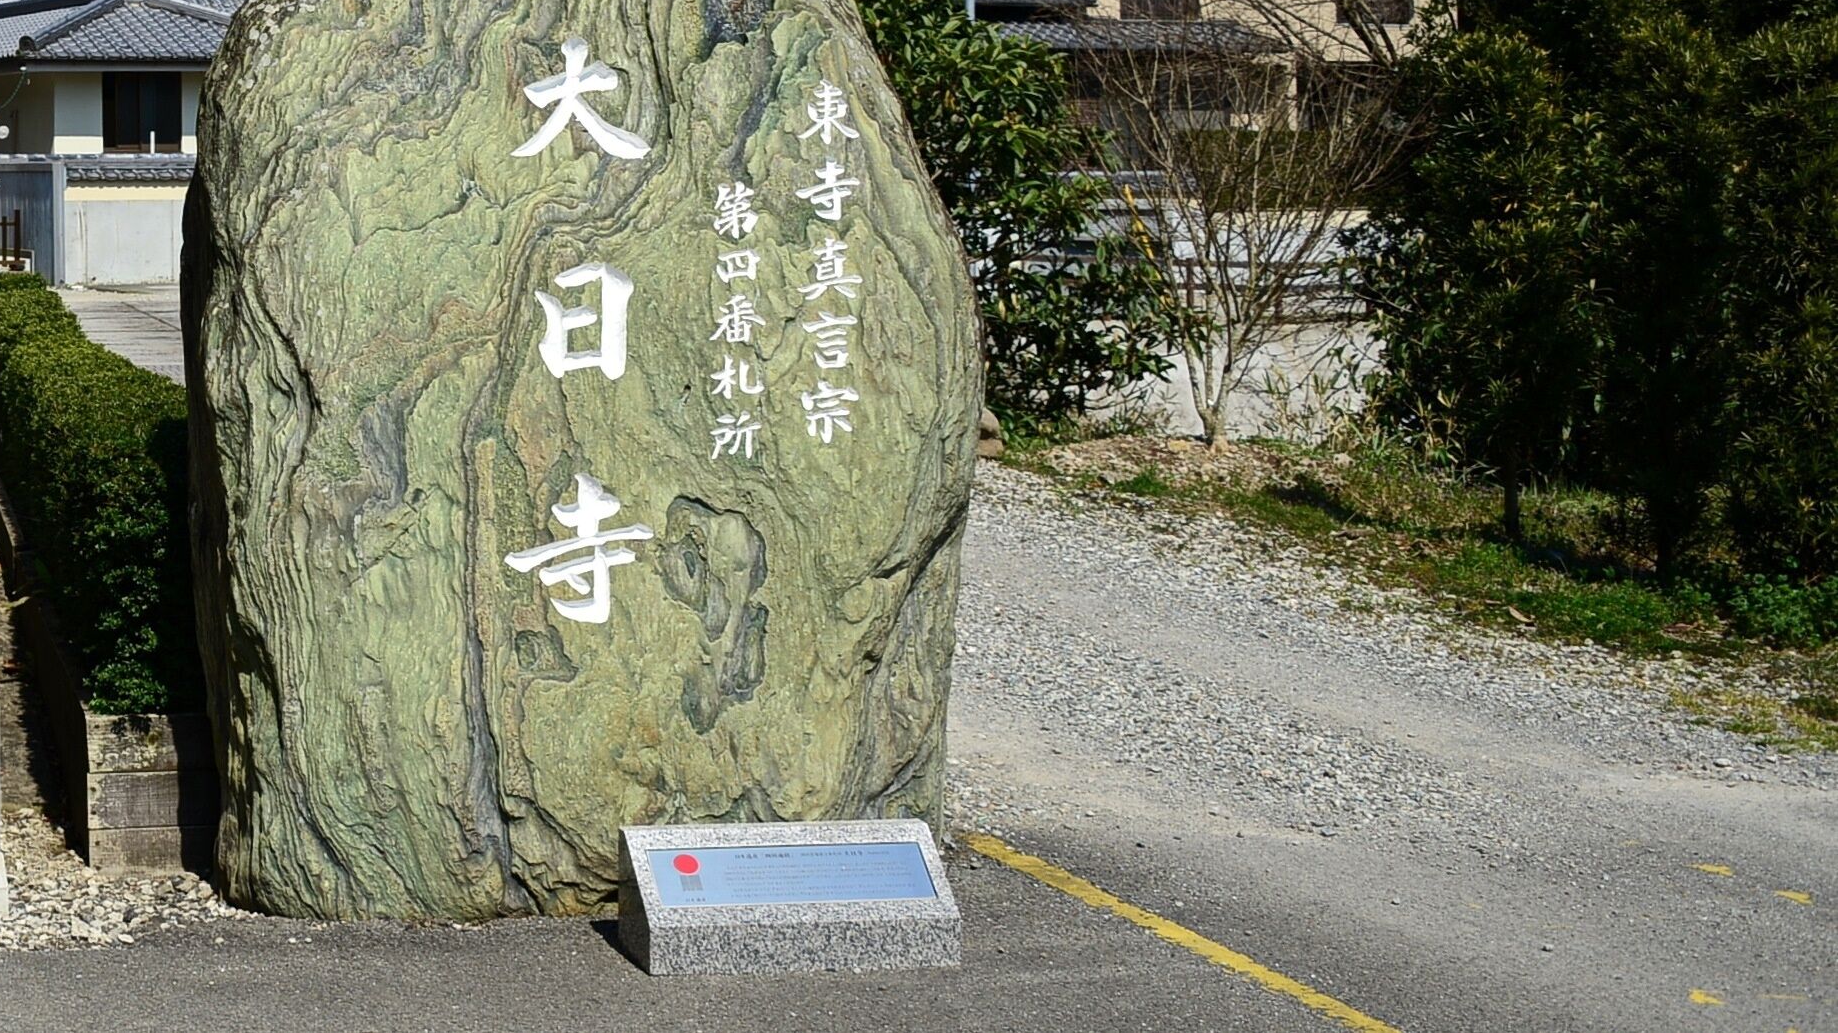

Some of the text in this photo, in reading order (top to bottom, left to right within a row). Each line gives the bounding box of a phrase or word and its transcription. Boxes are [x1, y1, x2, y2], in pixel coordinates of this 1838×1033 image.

[504, 36, 654, 623] 大日寺
[709, 181, 765, 460] 第四番札所
[795, 80, 863, 443] 東寺真言宗
